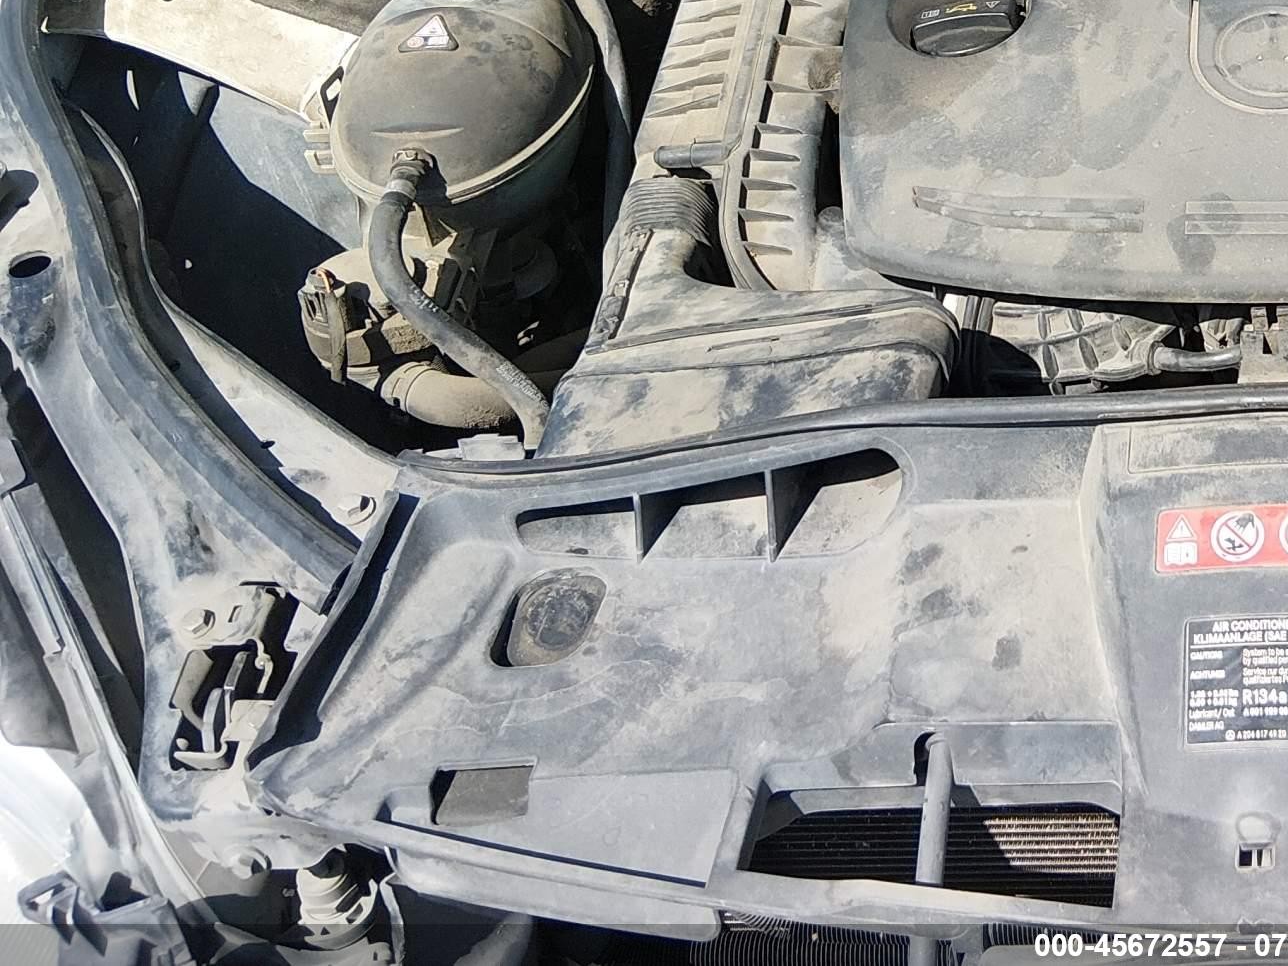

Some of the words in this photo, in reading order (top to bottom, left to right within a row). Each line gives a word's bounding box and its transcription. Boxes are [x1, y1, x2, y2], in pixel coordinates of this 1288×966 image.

[1212, 621, 1229, 632] AIR
[1193, 631, 1263, 644] KLIMAANLAGE
[1264, 631, 1287, 643] (SAE
[1242, 648, 1266, 658] System
[1268, 648, 1275, 656] to
[1242, 667, 1266, 676] Service
[1242, 688, 1288, 705] R134a
